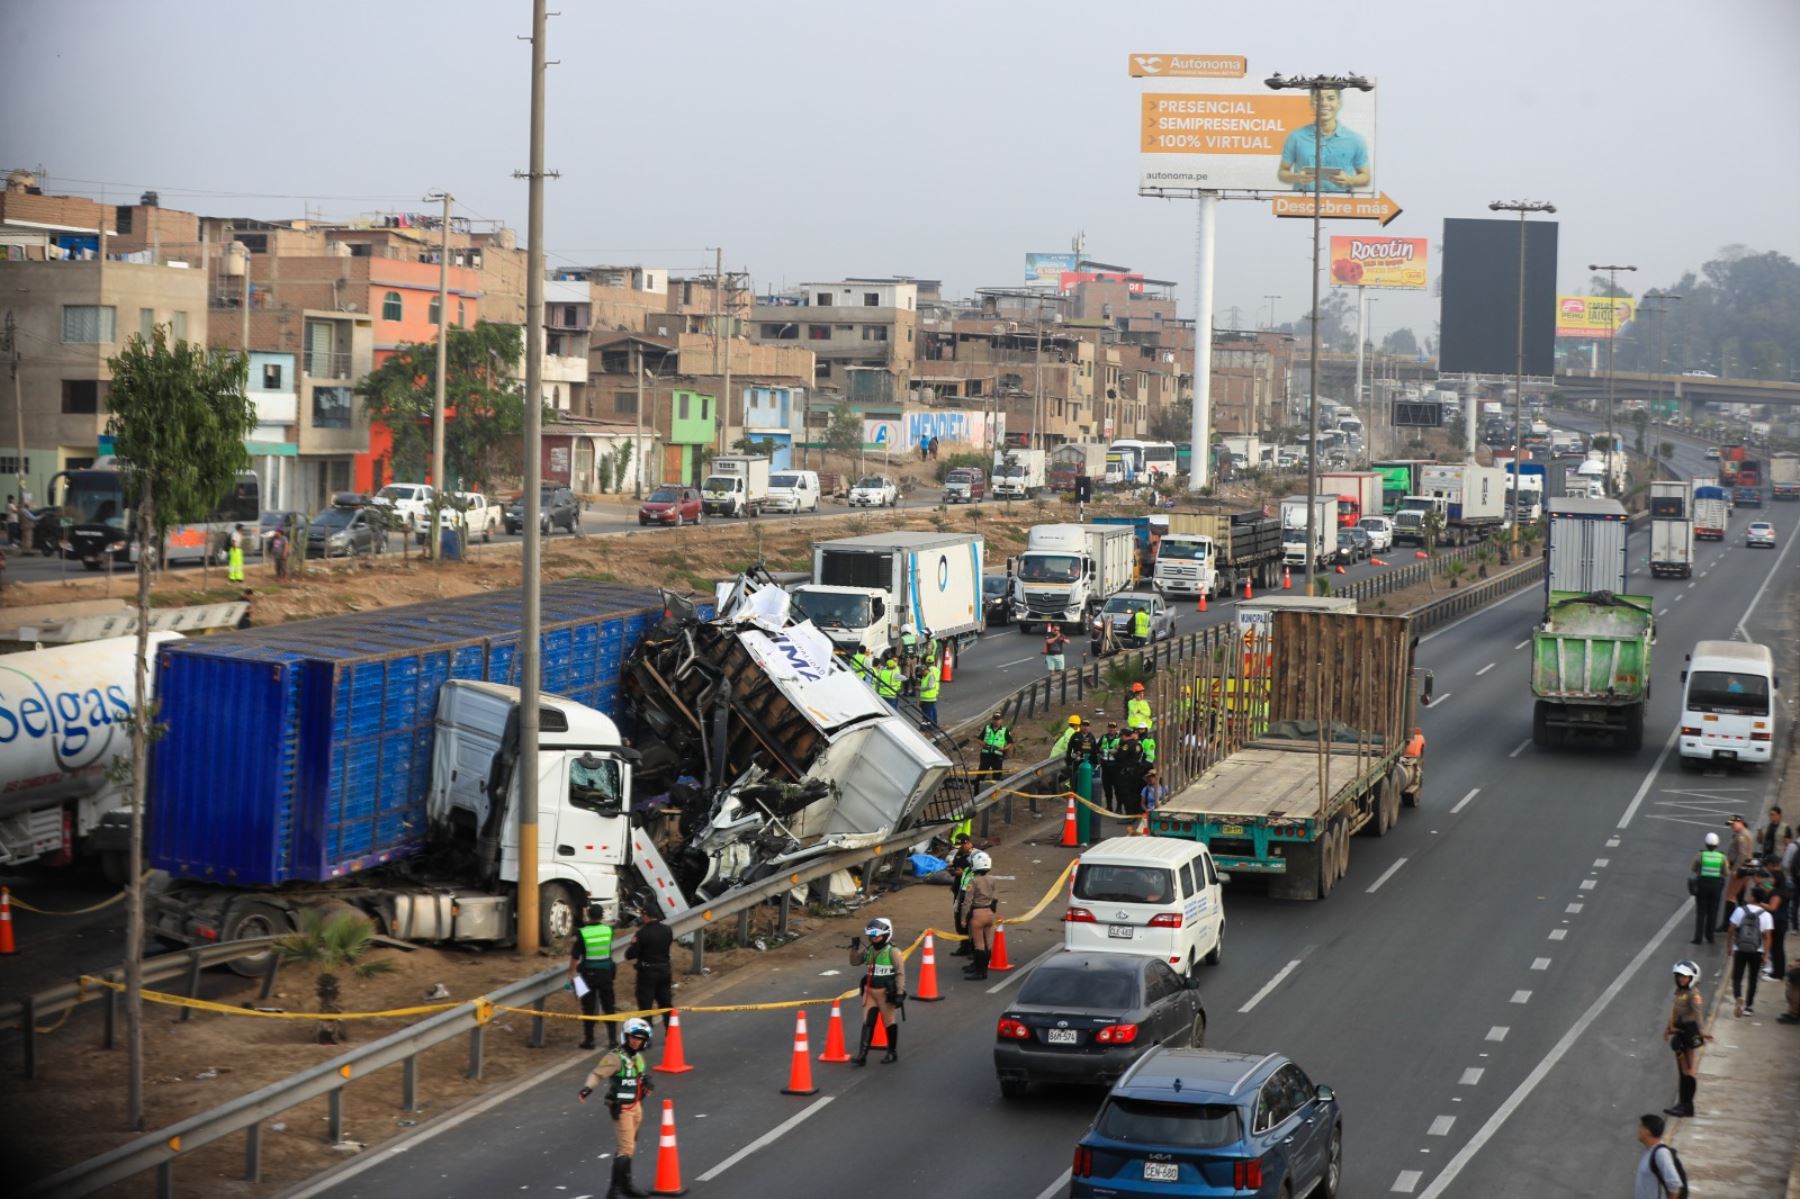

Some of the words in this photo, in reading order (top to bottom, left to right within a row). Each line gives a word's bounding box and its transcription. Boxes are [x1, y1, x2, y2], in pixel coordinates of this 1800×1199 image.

[1158, 100, 1255, 114] PRESENCIAL
[1158, 117, 1285, 132] SEMIPRESENCIAL
[1158, 135, 1201, 147] 100%
[1205, 136, 1272, 149] VIRTUAL
[1146, 172, 1208, 181] autonoma.pe
[1357, 201, 1389, 214] más
